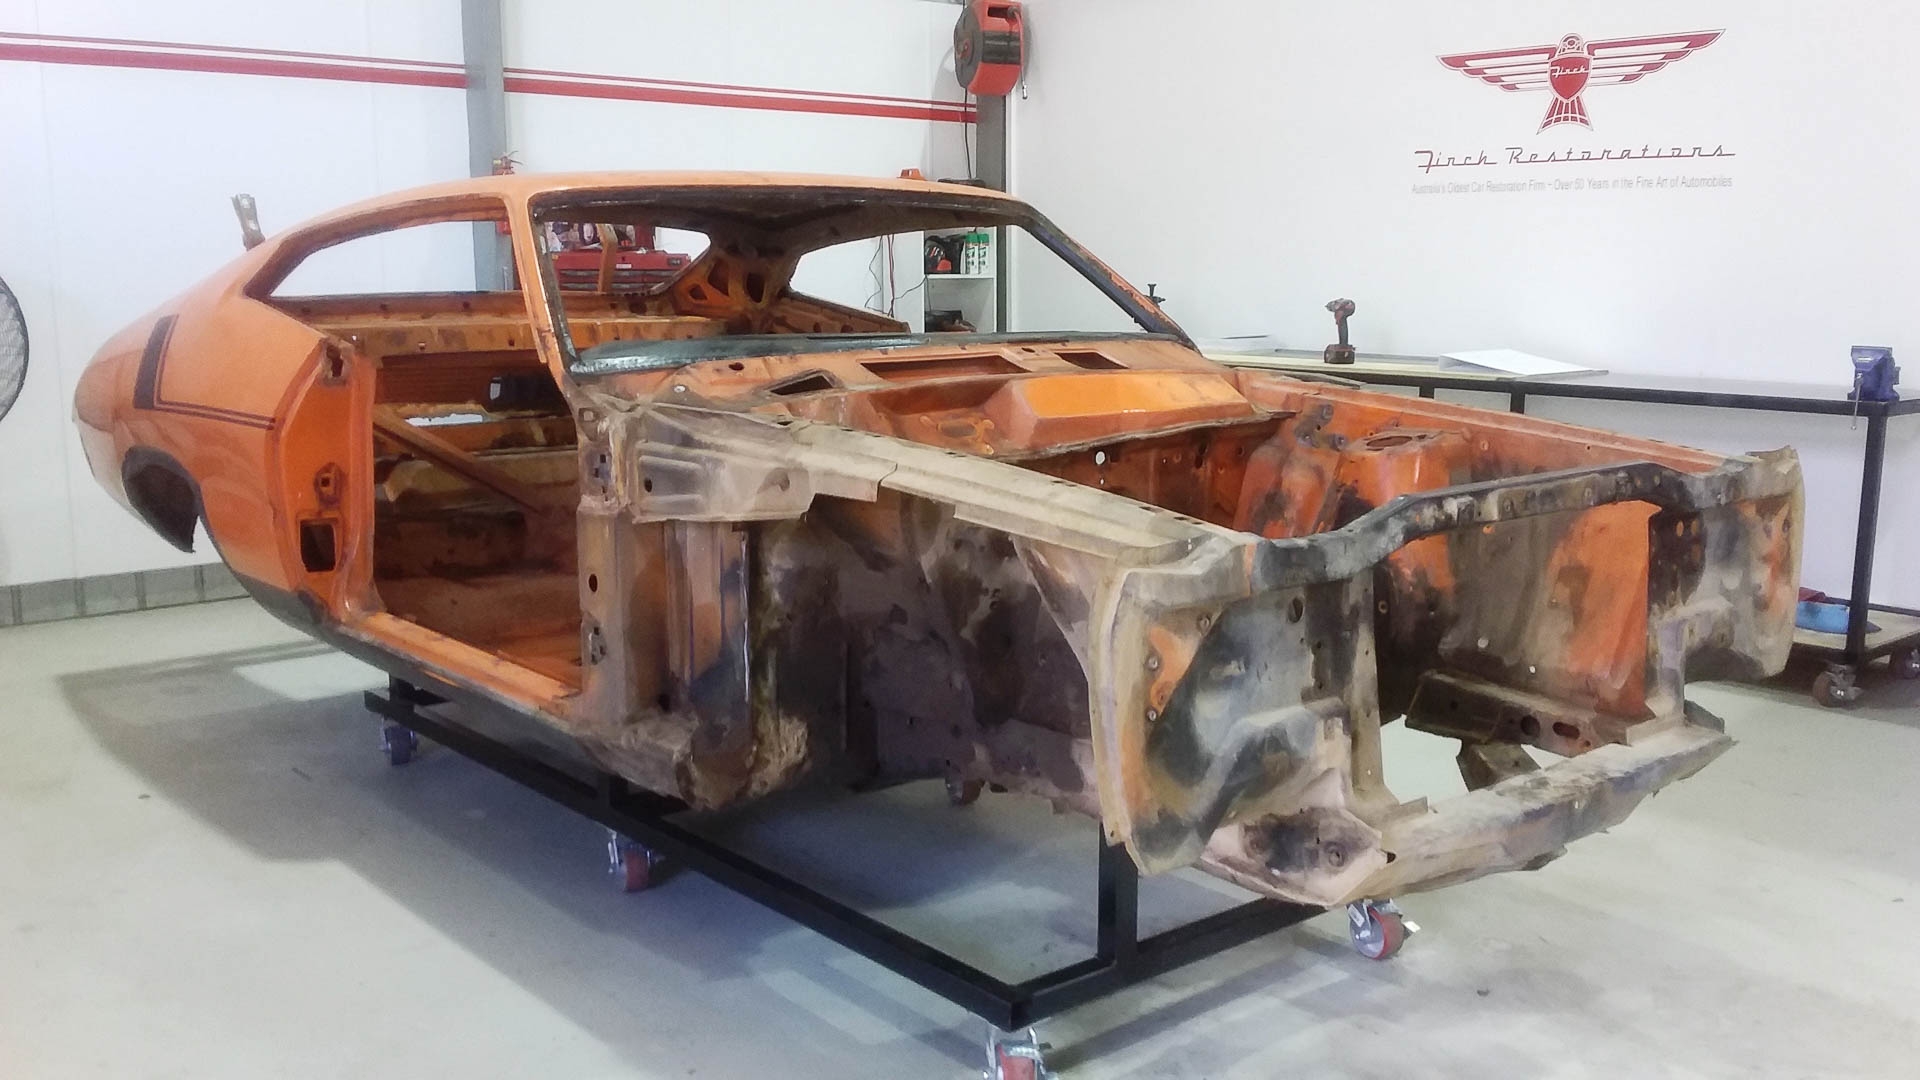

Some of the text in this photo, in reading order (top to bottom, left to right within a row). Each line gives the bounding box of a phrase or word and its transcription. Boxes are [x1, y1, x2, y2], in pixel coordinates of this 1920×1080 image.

[1550, 65, 1590, 79] Finch
[1414, 145, 1736, 174] Finch Restorations
[1447, 181, 1470, 194] Oldest
[1471, 181, 1485, 193] Car
[1486, 180, 1526, 193] Restoration
[1528, 179, 1546, 192] Firm
[1554, 178, 1573, 191] Over
[1587, 177, 1609, 190] Years
[1611, 178, 1620, 189] in
[1621, 177, 1633, 189] the
[1636, 175, 1654, 188] Fine
[1656, 175, 1669, 188] Art
[1670, 175, 1680, 188] of
[1681, 174, 1733, 188] Automobiles
